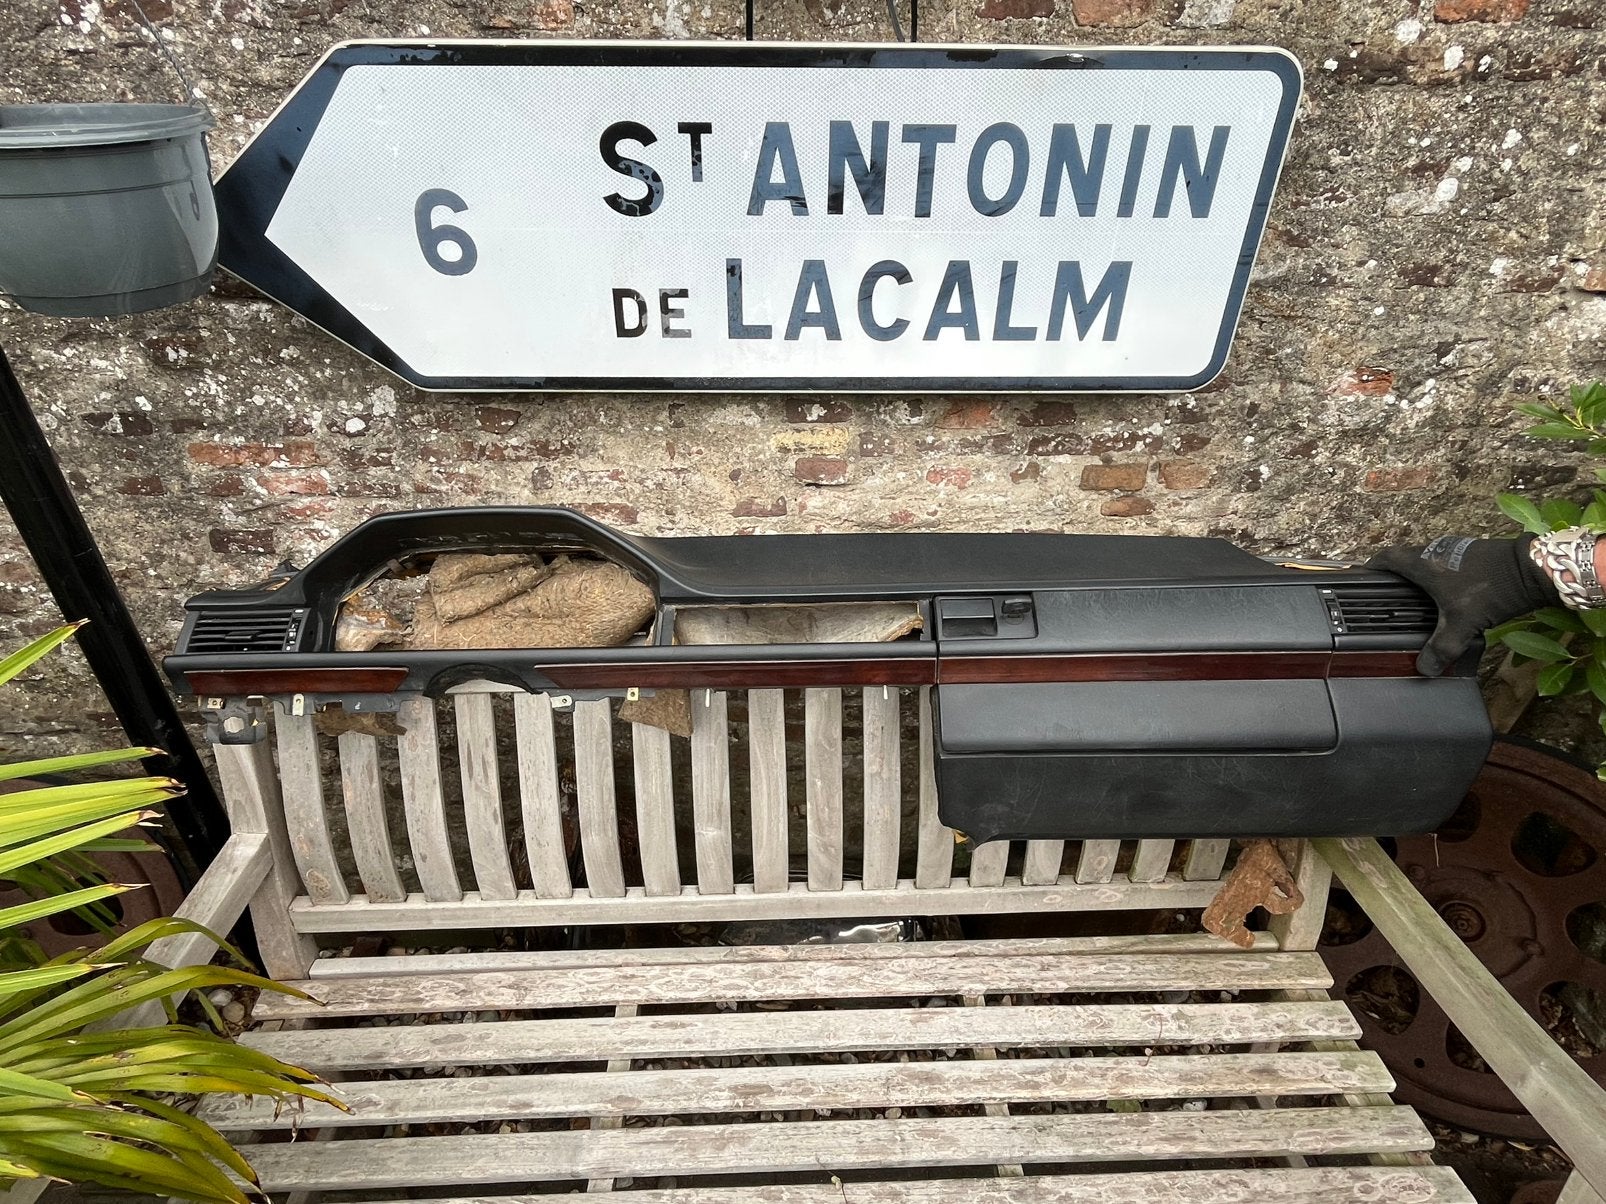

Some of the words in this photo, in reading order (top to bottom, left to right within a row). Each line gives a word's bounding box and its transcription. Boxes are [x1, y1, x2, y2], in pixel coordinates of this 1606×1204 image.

[746, 120, 1231, 218] ANTONIN
[414, 188, 478, 276] 6
[611, 287, 692, 339] DE
[725, 257, 1133, 341] LACALM
